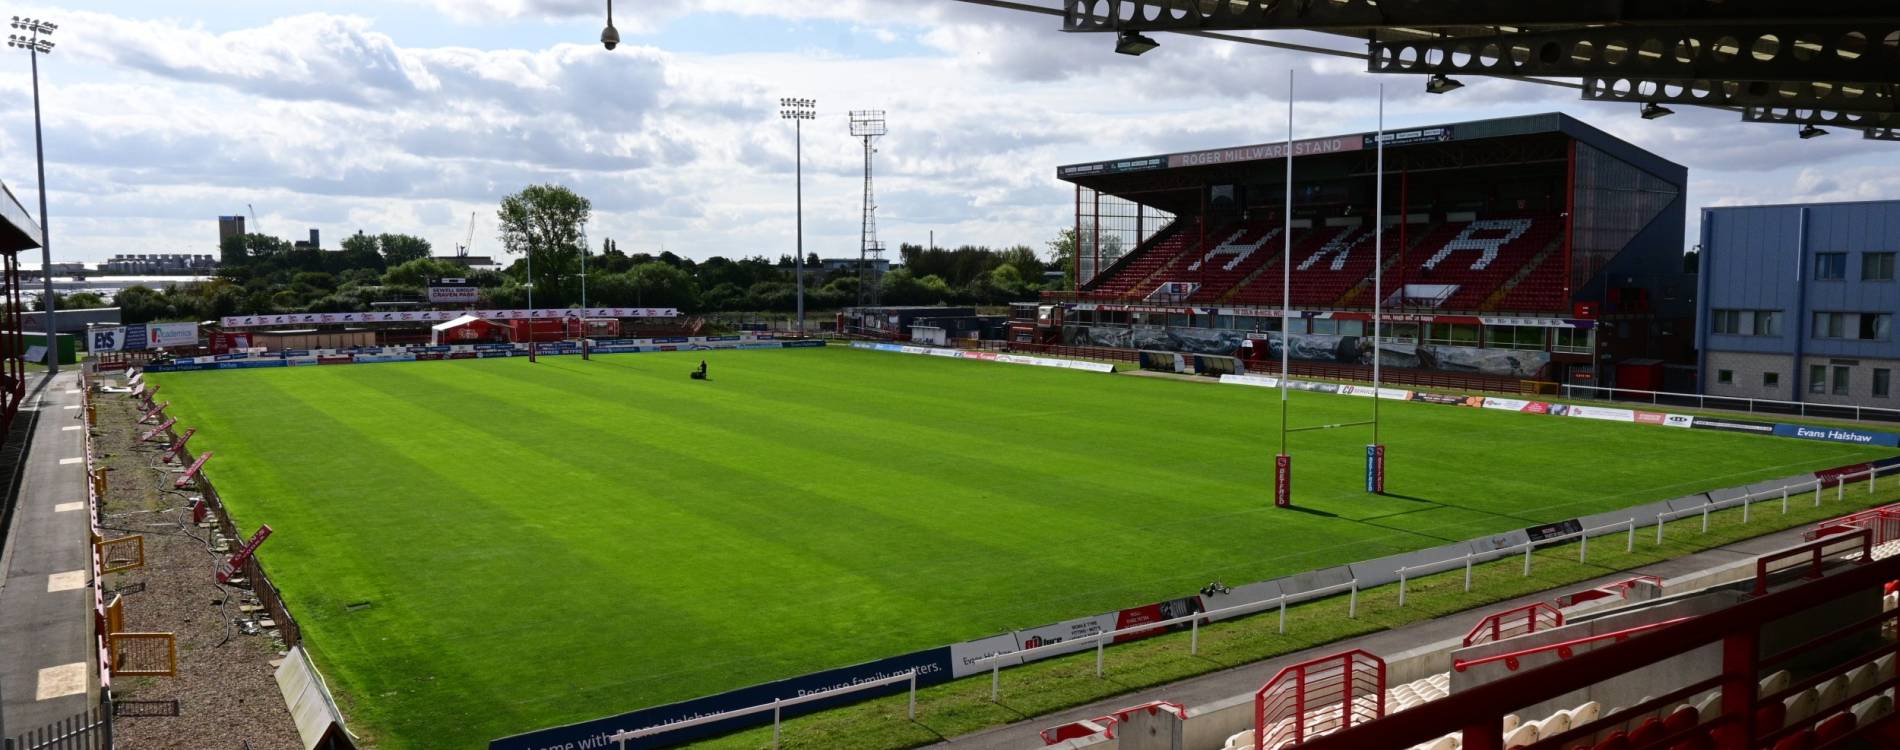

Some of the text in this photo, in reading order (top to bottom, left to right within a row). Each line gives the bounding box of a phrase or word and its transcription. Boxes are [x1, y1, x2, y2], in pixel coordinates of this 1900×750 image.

[1182, 152, 1221, 167] ROGER
[1225, 144, 1290, 163] MILLWARD
[1295, 139, 1342, 155] STAND
[1421, 218, 1533, 271] R
[1797, 427, 1872, 442] Evans Halshaw
[797, 661, 942, 697] Because family maters.
[577, 732, 612, 750] with
